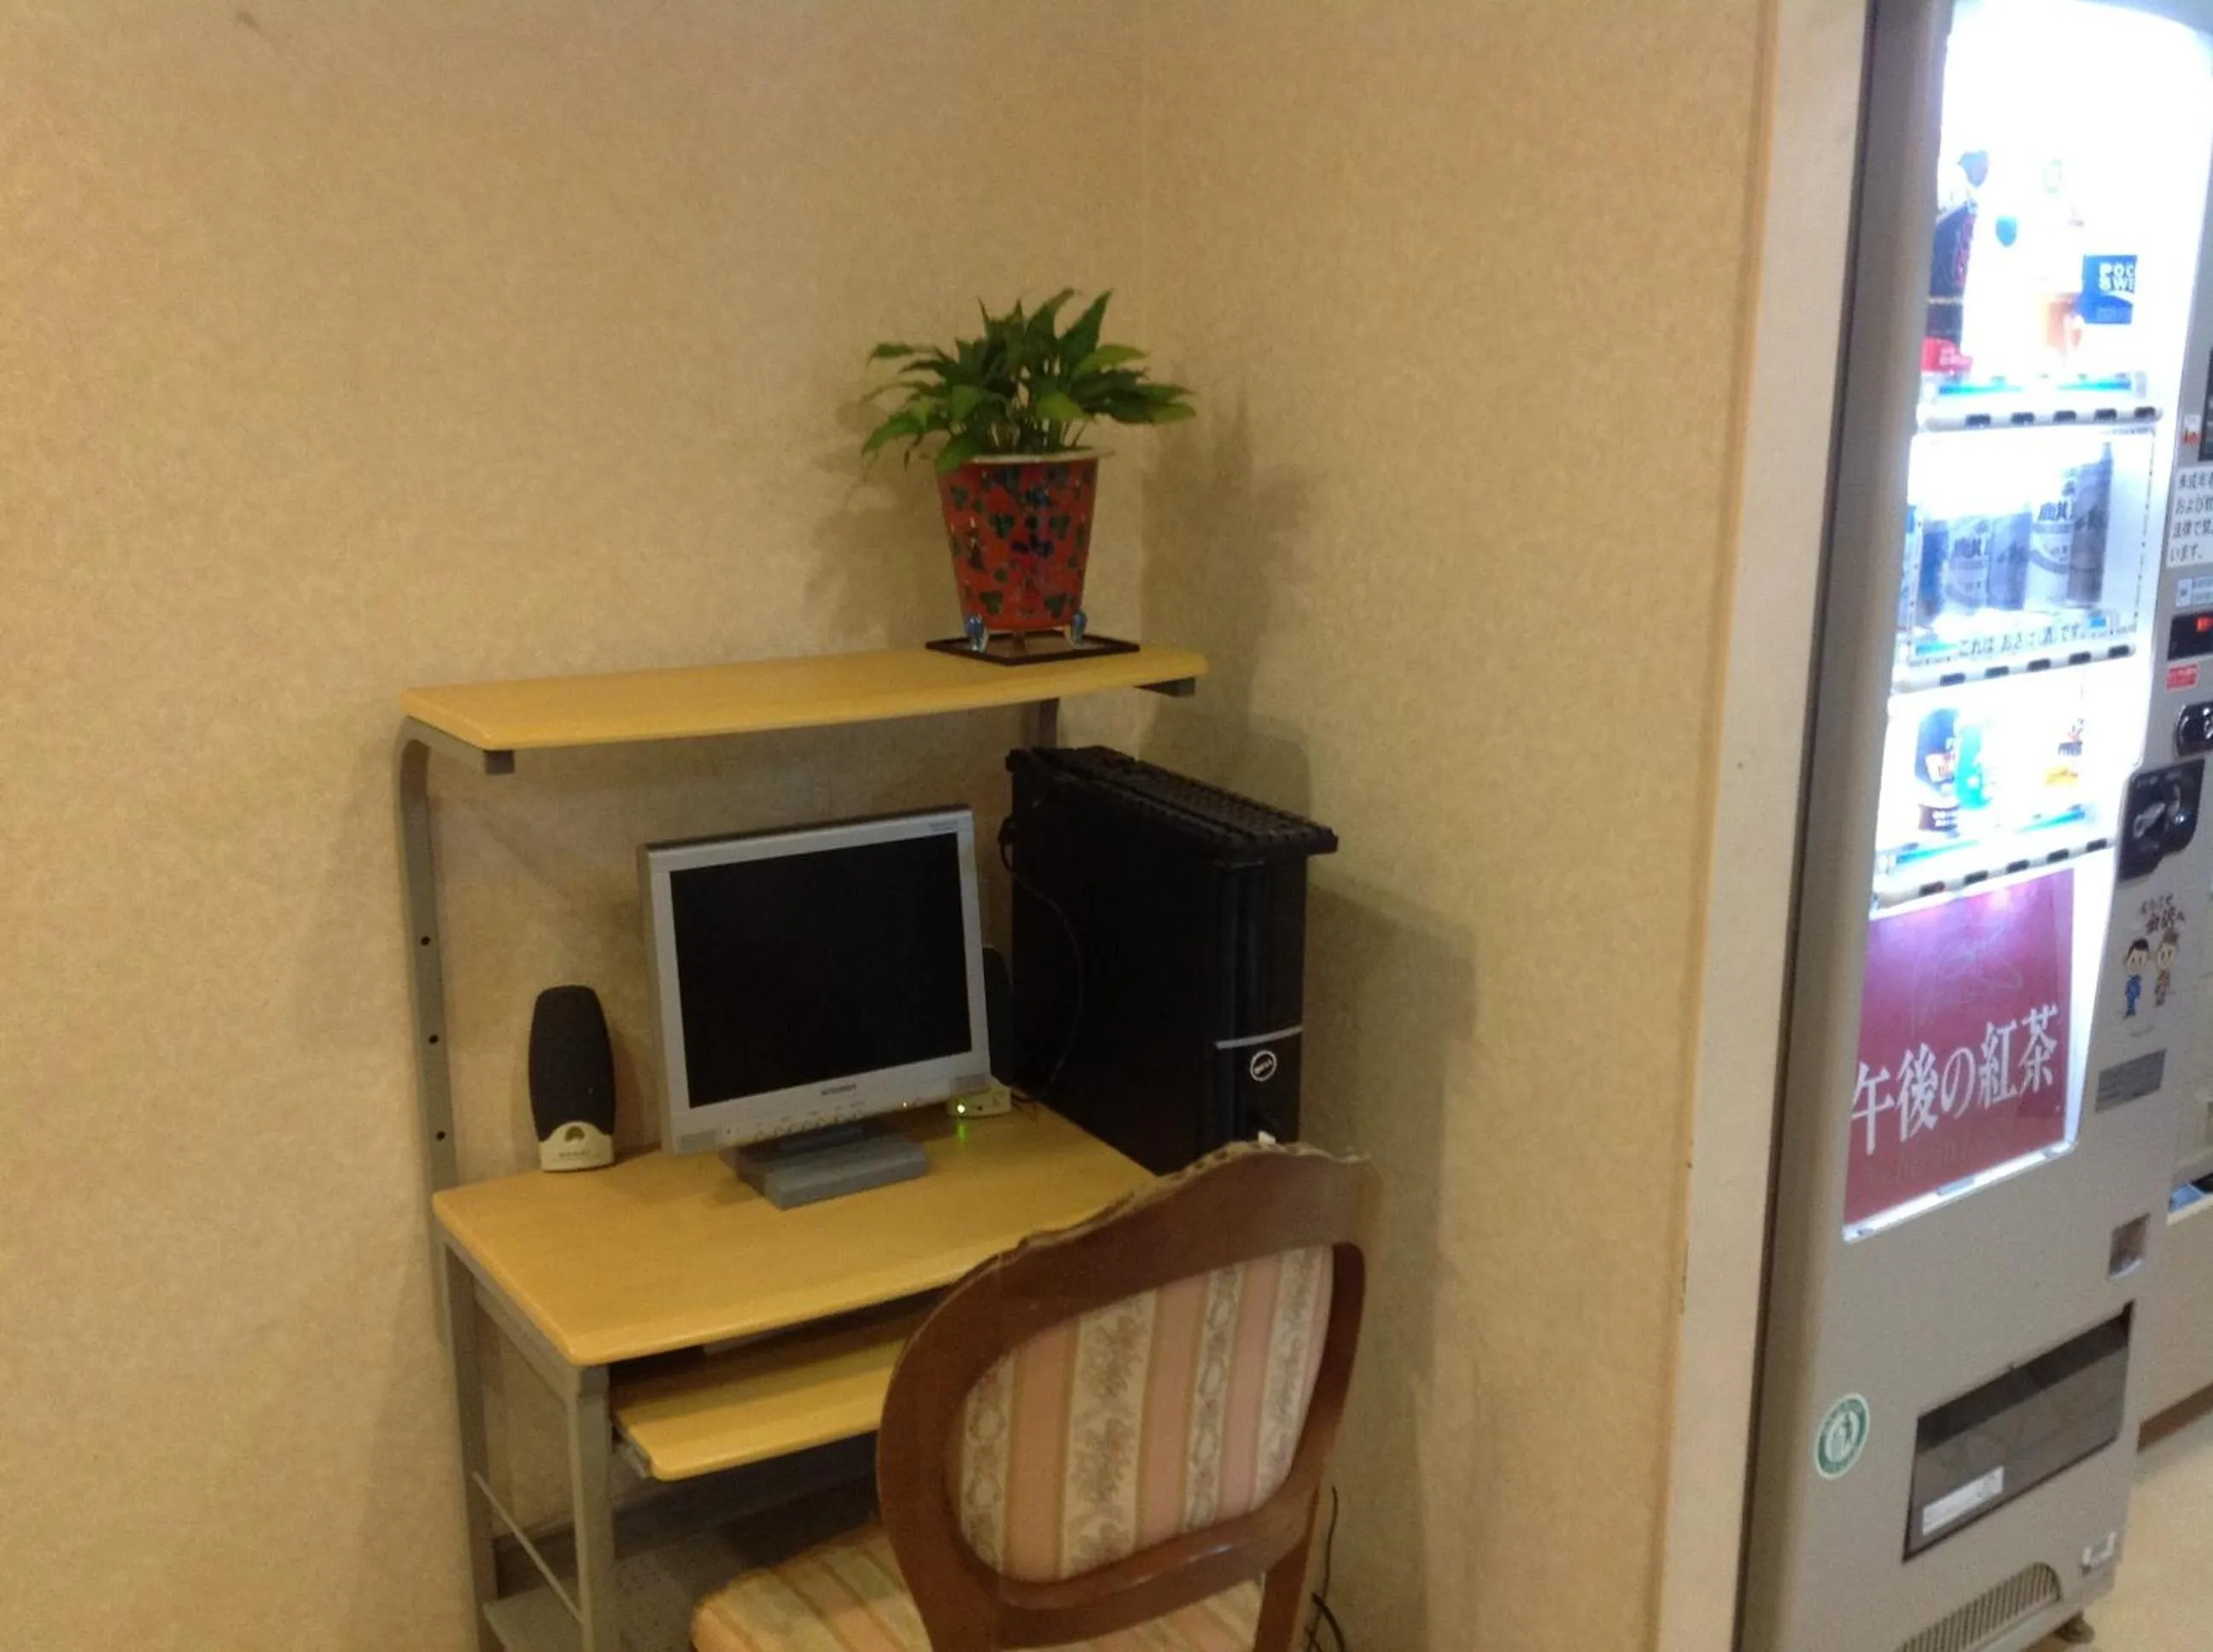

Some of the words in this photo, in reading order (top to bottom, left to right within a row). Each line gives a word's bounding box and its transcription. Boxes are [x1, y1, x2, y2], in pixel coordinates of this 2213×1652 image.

[1851, 1003, 2058, 1156] 午後の紅茶
